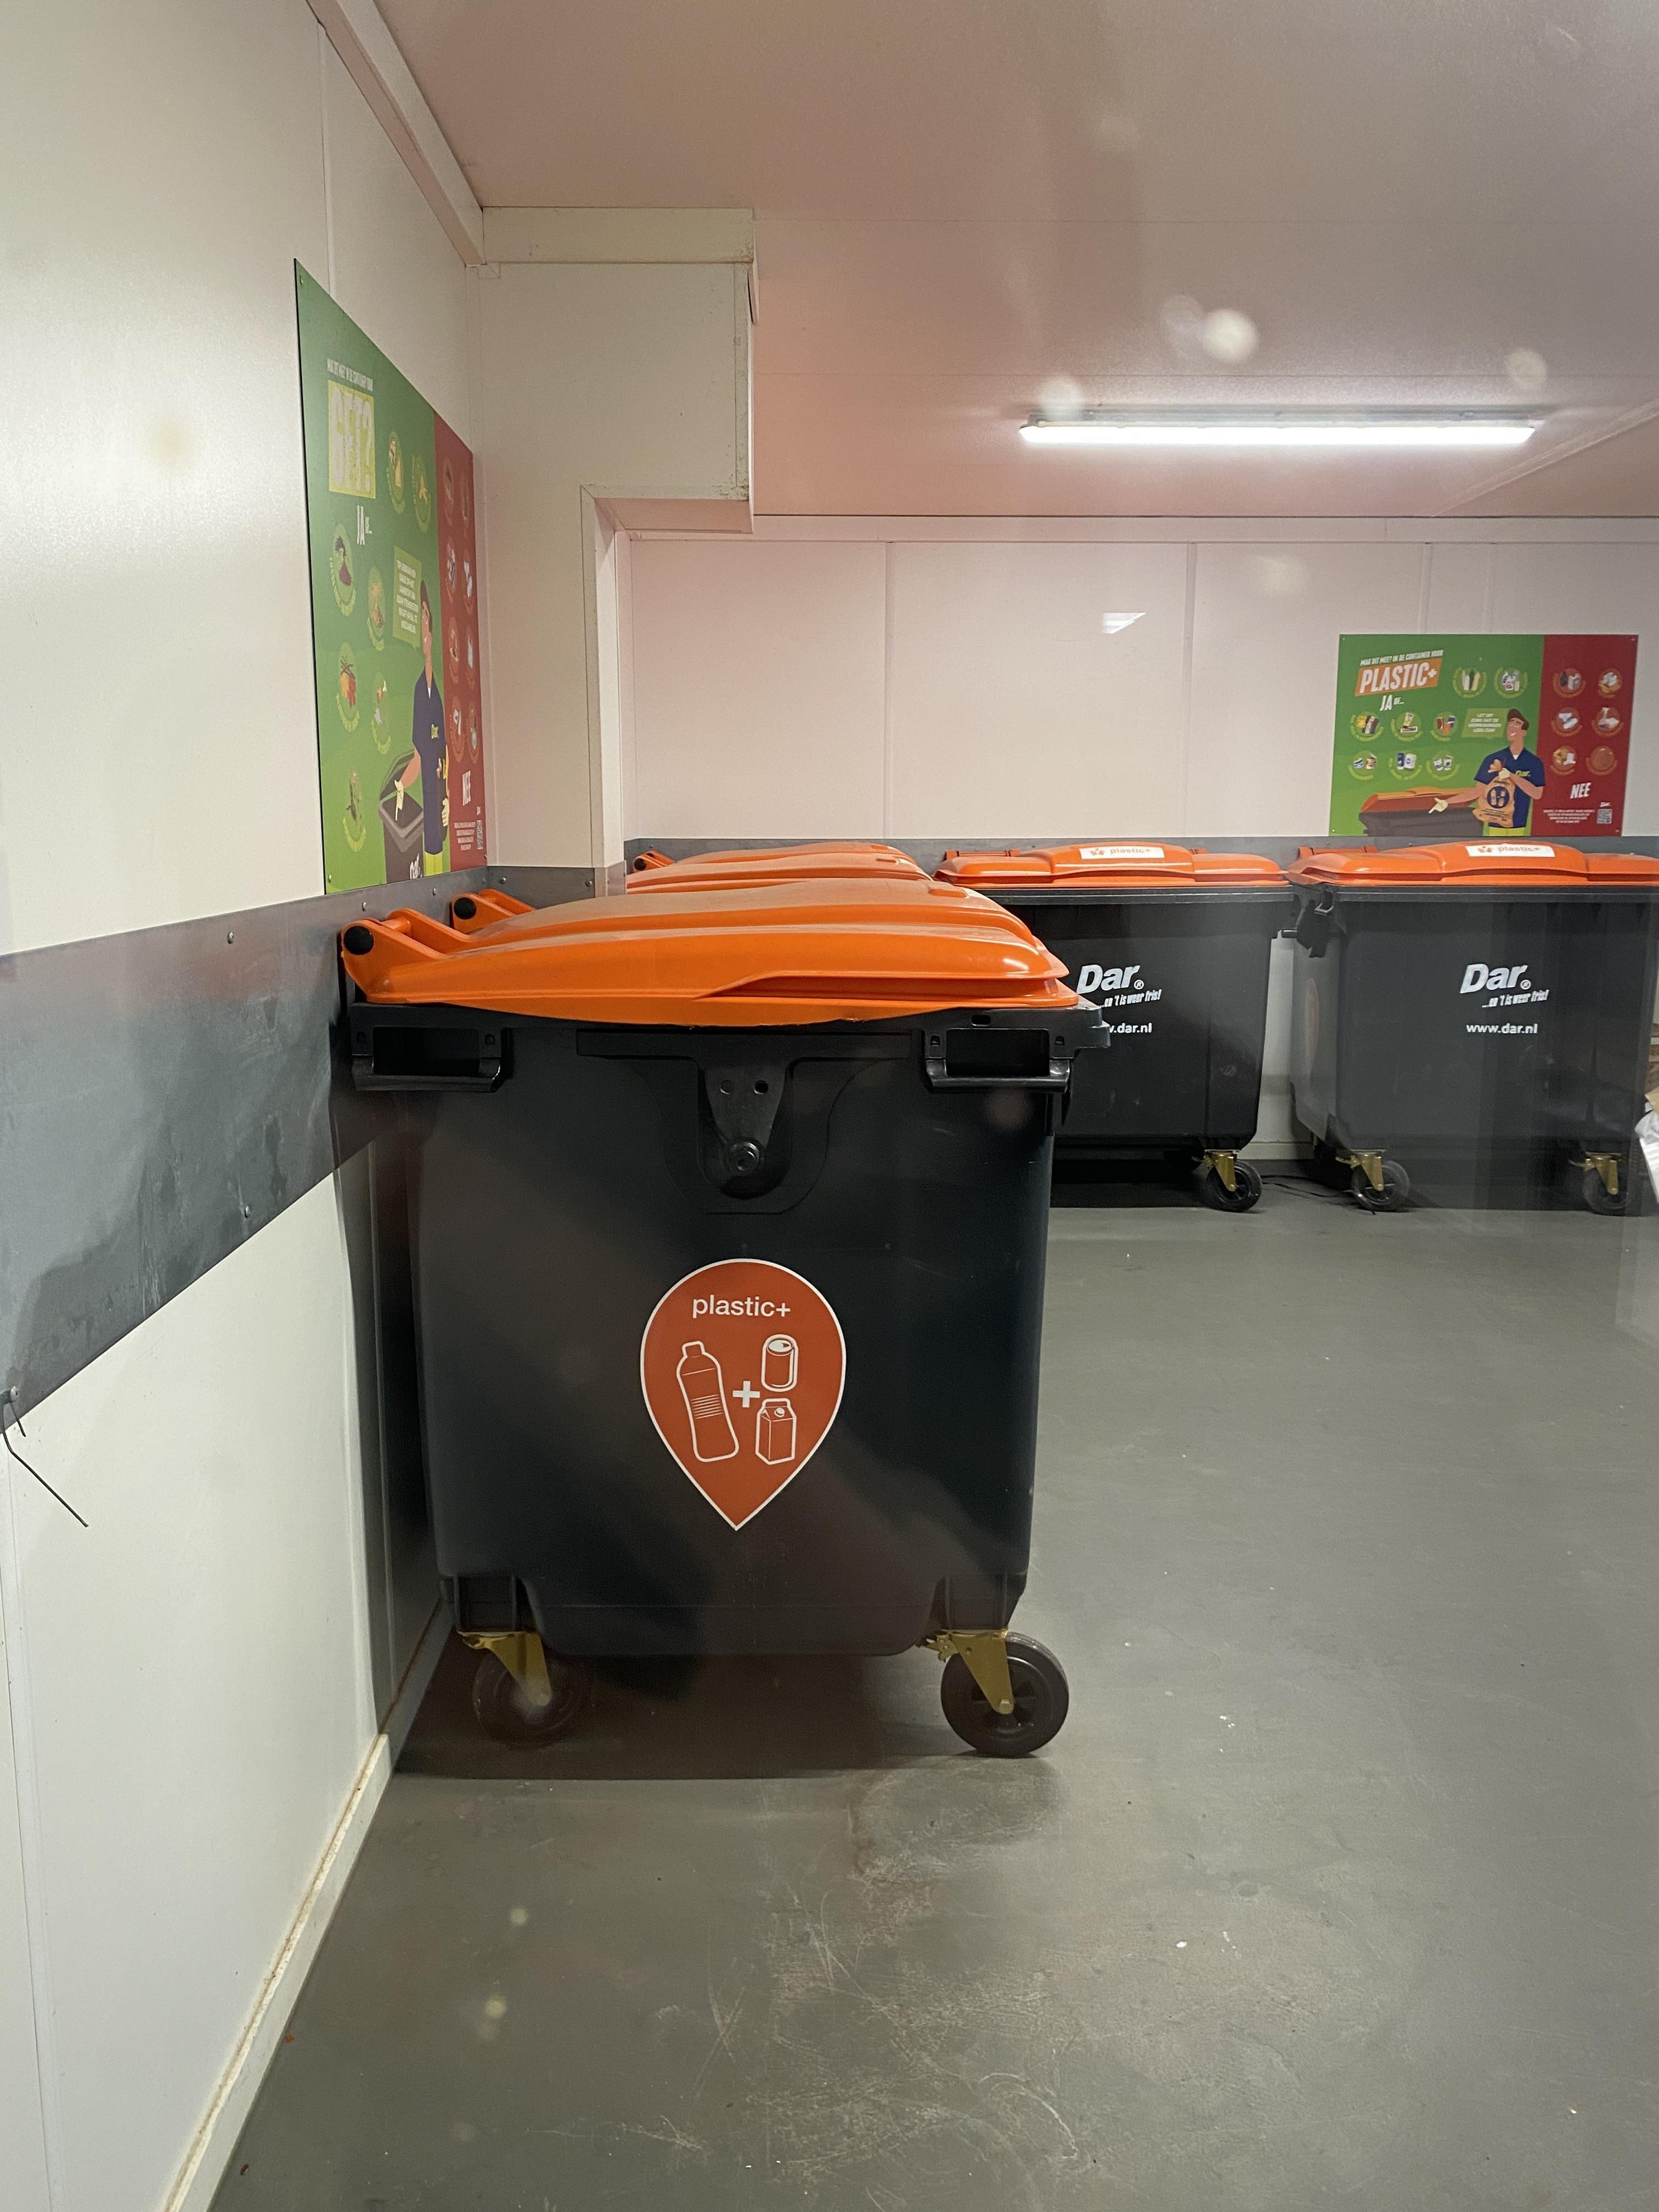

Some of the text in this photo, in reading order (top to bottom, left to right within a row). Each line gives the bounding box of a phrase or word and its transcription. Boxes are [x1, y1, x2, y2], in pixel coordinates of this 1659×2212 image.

[331, 387, 372, 493] GFT?
[357, 505, 365, 545] JA
[1359, 662, 1437, 693] PLASTIC+
[1379, 694, 1392, 711] JA
[462, 770, 471, 806] NEE
[1570, 782, 1591, 799] NEE
[1126, 992, 1145, 1004] weer
[1144, 989, 1162, 1002] fris!
[1466, 1023, 1538, 1034] www.dar.nl
[692, 1294, 791, 1319] plastic+
